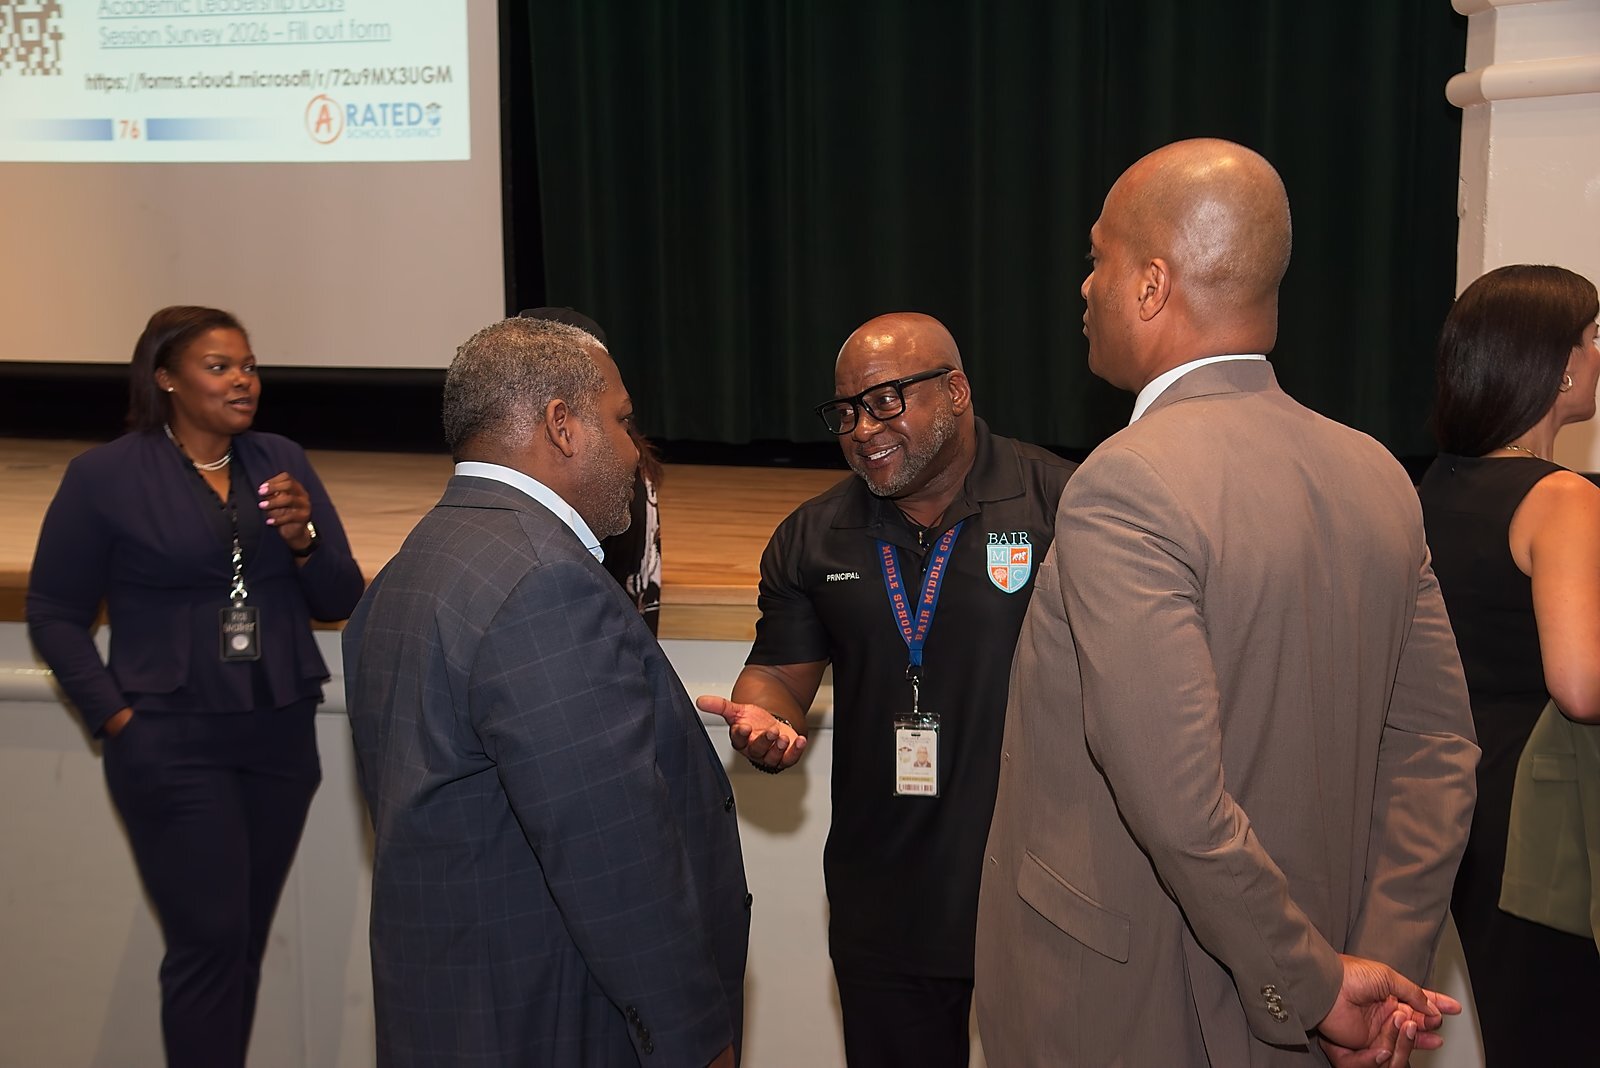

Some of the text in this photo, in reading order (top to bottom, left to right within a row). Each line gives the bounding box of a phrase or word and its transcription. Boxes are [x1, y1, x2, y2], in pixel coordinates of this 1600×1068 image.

[100, 26, 161, 46] Session
[164, 24, 224, 46] Survey
[228, 22, 270, 43] 2026
[287, 20, 310, 41] Fill
[313, 20, 344, 40] out
[350, 18, 392, 39] form
[315, 102, 424, 133] A RATED
[119, 119, 140, 139] 76
[987, 531, 1030, 545] BAIR
[992, 550, 1006, 562] M
[826, 571, 861, 583] PRINCIPAL
[882, 545, 899, 590] MIDDLE
[1012, 569, 1024, 581] C
[914, 610, 931, 641] BAIR
[923, 555, 945, 605] MIDDLE
